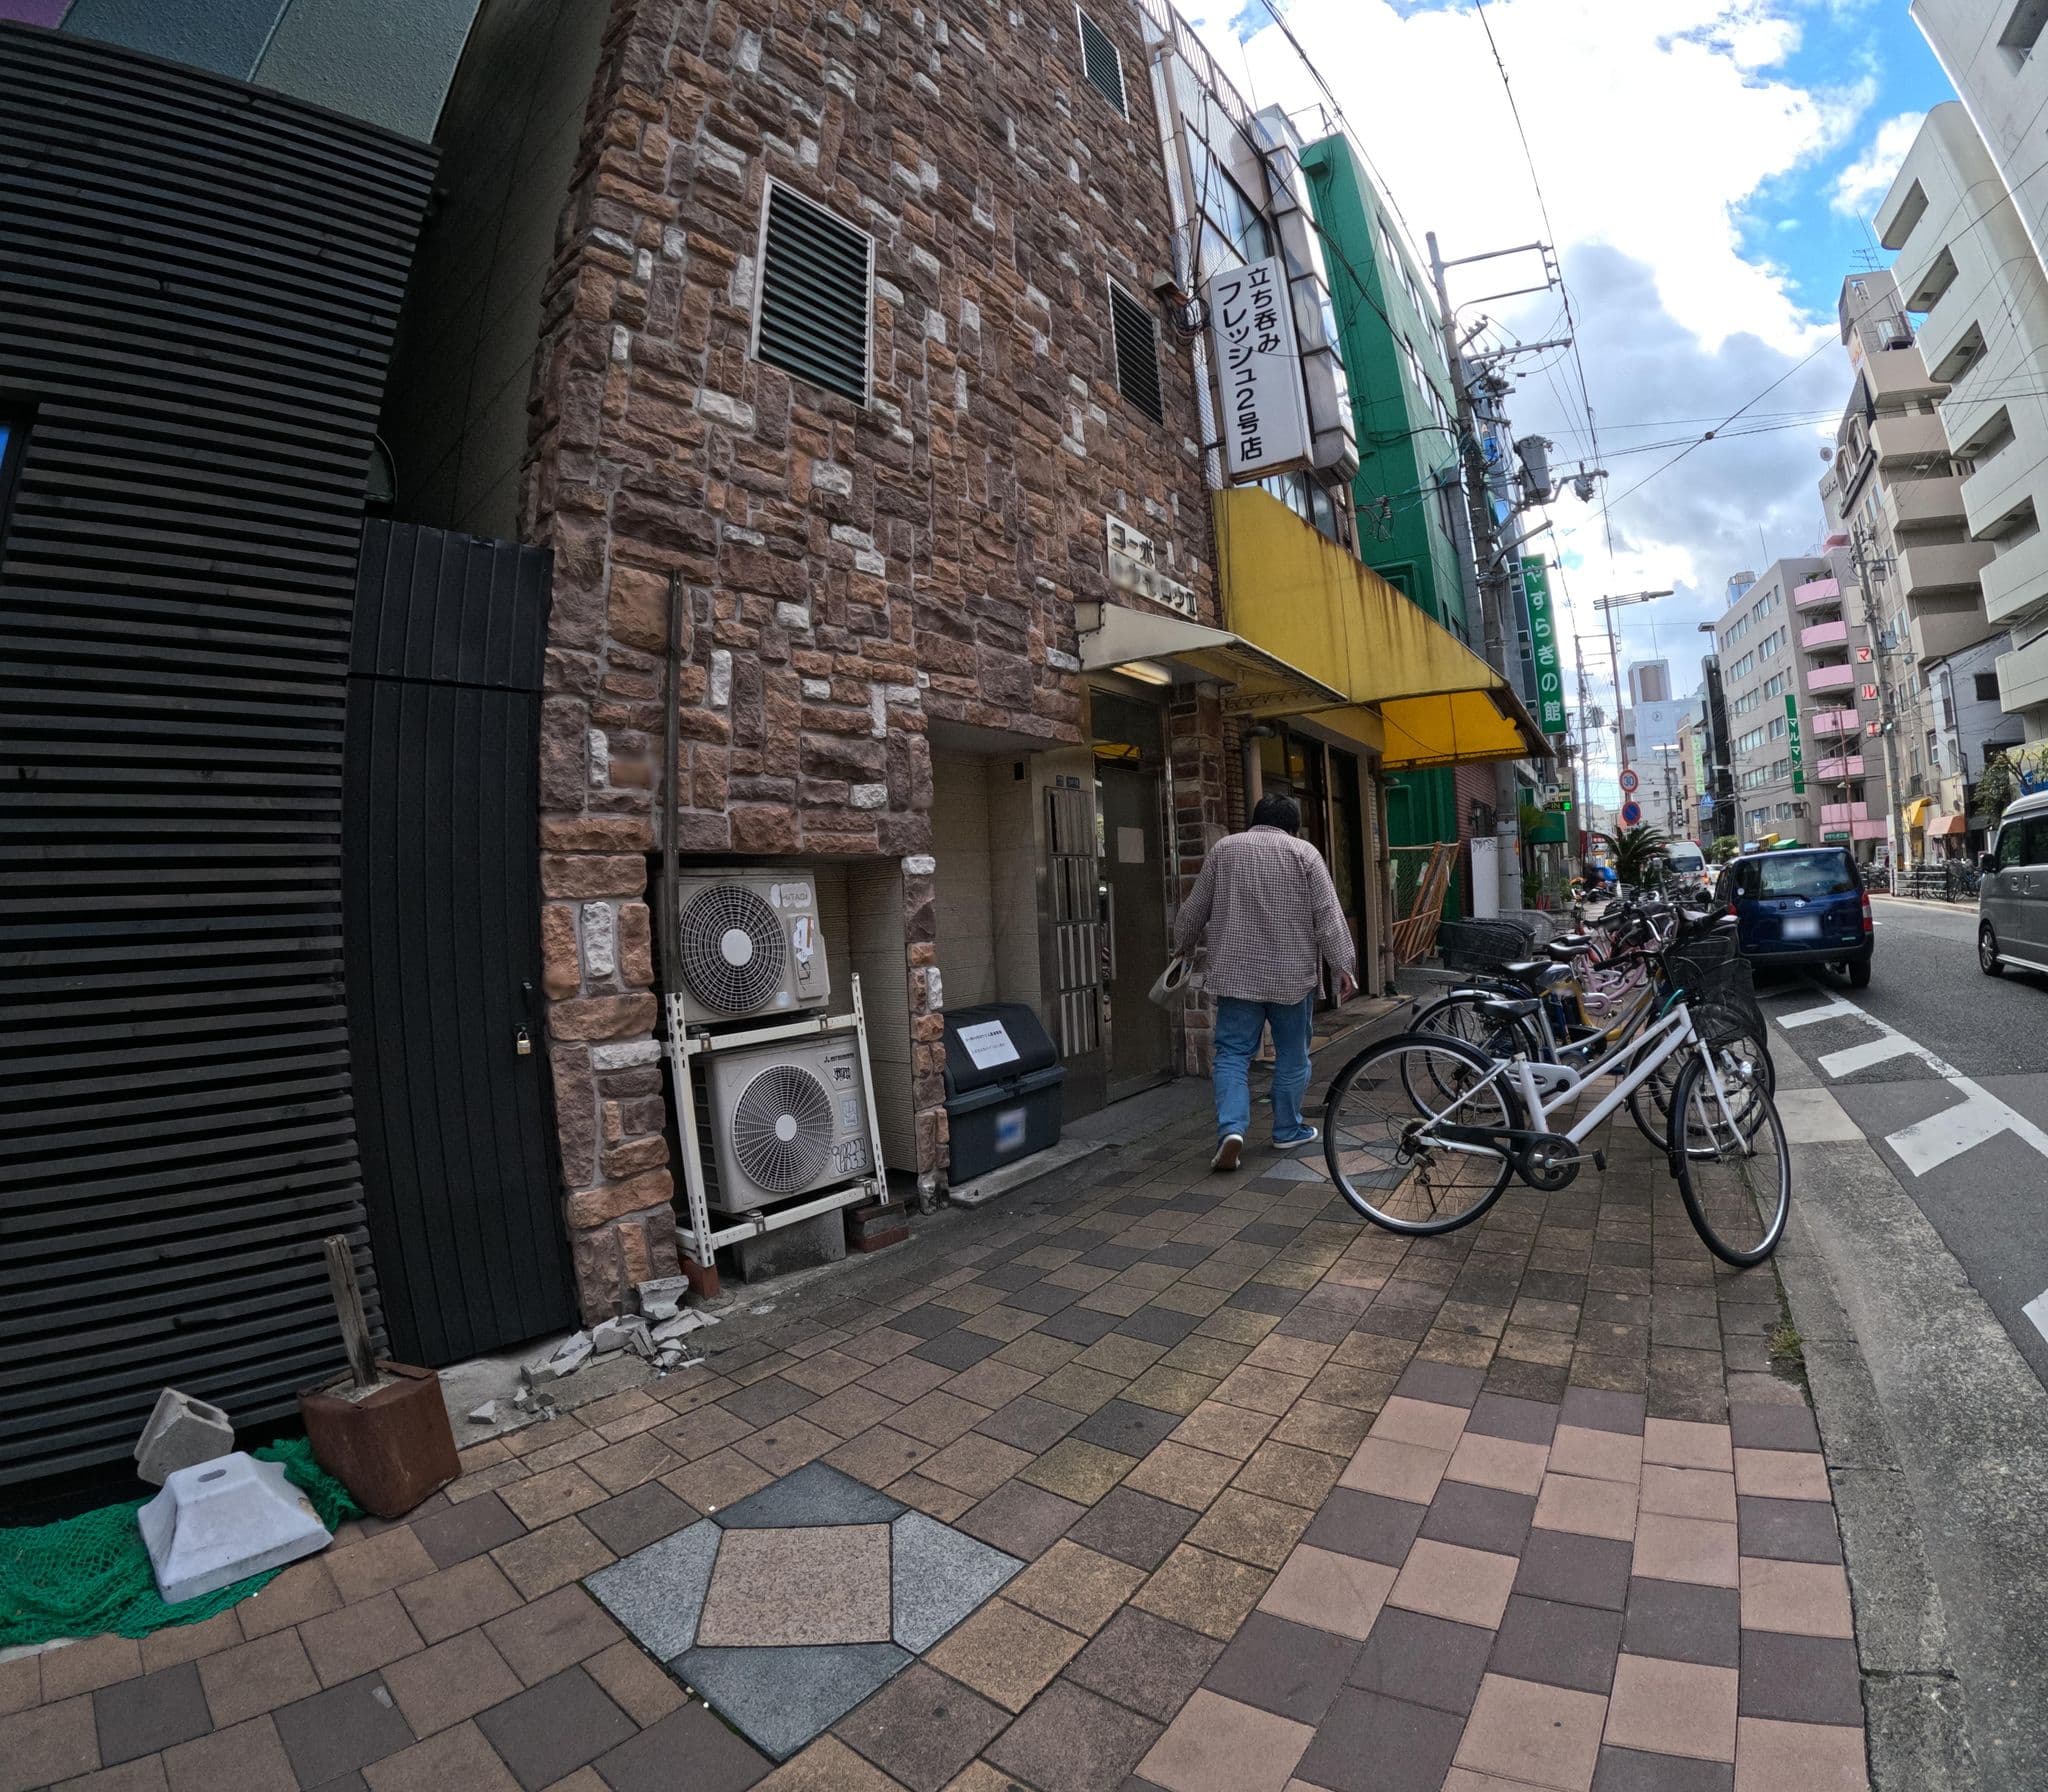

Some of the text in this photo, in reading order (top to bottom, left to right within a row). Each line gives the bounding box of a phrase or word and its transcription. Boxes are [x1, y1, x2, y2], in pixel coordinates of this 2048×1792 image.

[1218, 281, 1263, 462] フレッシュ2号店
[1248, 267, 1281, 353] 立ち呑み
